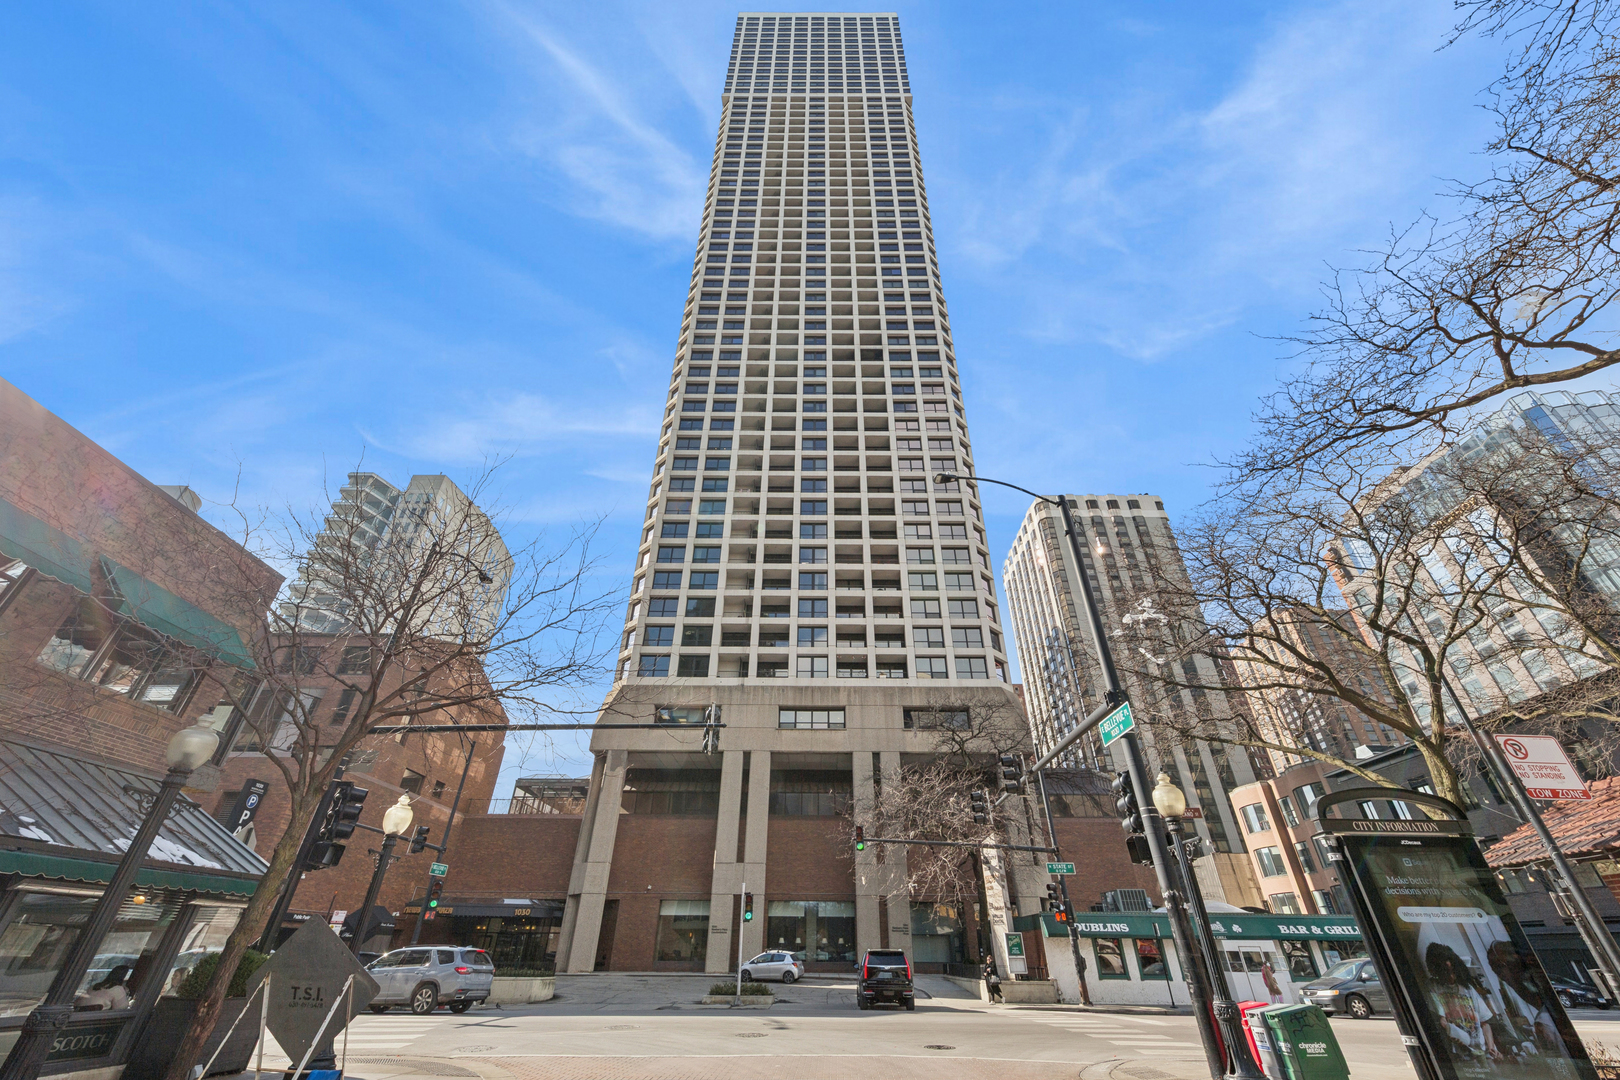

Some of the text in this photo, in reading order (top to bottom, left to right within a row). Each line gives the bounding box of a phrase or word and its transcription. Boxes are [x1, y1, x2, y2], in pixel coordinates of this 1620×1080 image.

[1103, 710, 1125, 732] BELLEVUE
[1531, 772, 1566, 780] STANDING
[1529, 788, 1587, 799] TOW ZONE
[1352, 821, 1440, 832] CITY INFORMATION
[1386, 876, 1409, 884] Make
[1408, 876, 1433, 885] better
[1384, 887, 1422, 896] decisions
[1421, 887, 1440, 896] with
[1073, 923, 1130, 933] DUBLINS
[1277, 925, 1309, 934] BAR
[1310, 925, 1323, 934] &
[291, 986, 323, 1001] T.S.I.
